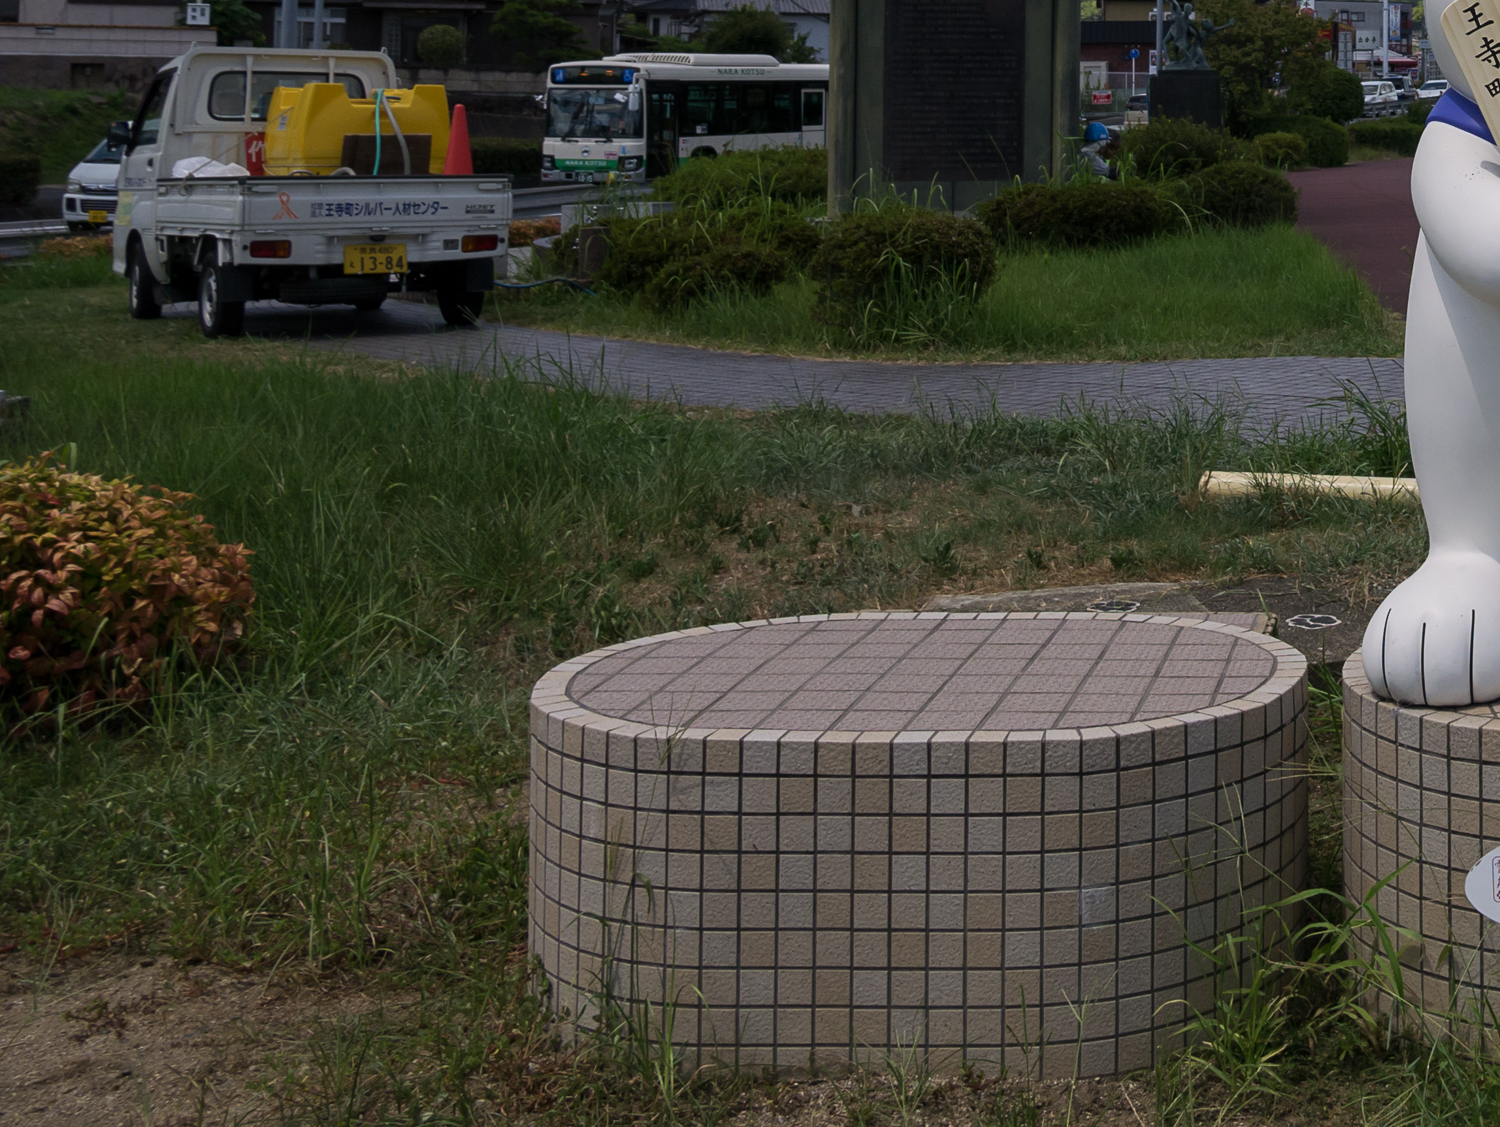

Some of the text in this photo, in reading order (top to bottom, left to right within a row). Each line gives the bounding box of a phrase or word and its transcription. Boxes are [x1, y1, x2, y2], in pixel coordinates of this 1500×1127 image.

[717, 68, 765, 76] NARA KOTSU
[325, 201, 449, 218] 王寺町シルバー人材センター
[361, 255, 404, 271] 13-84
